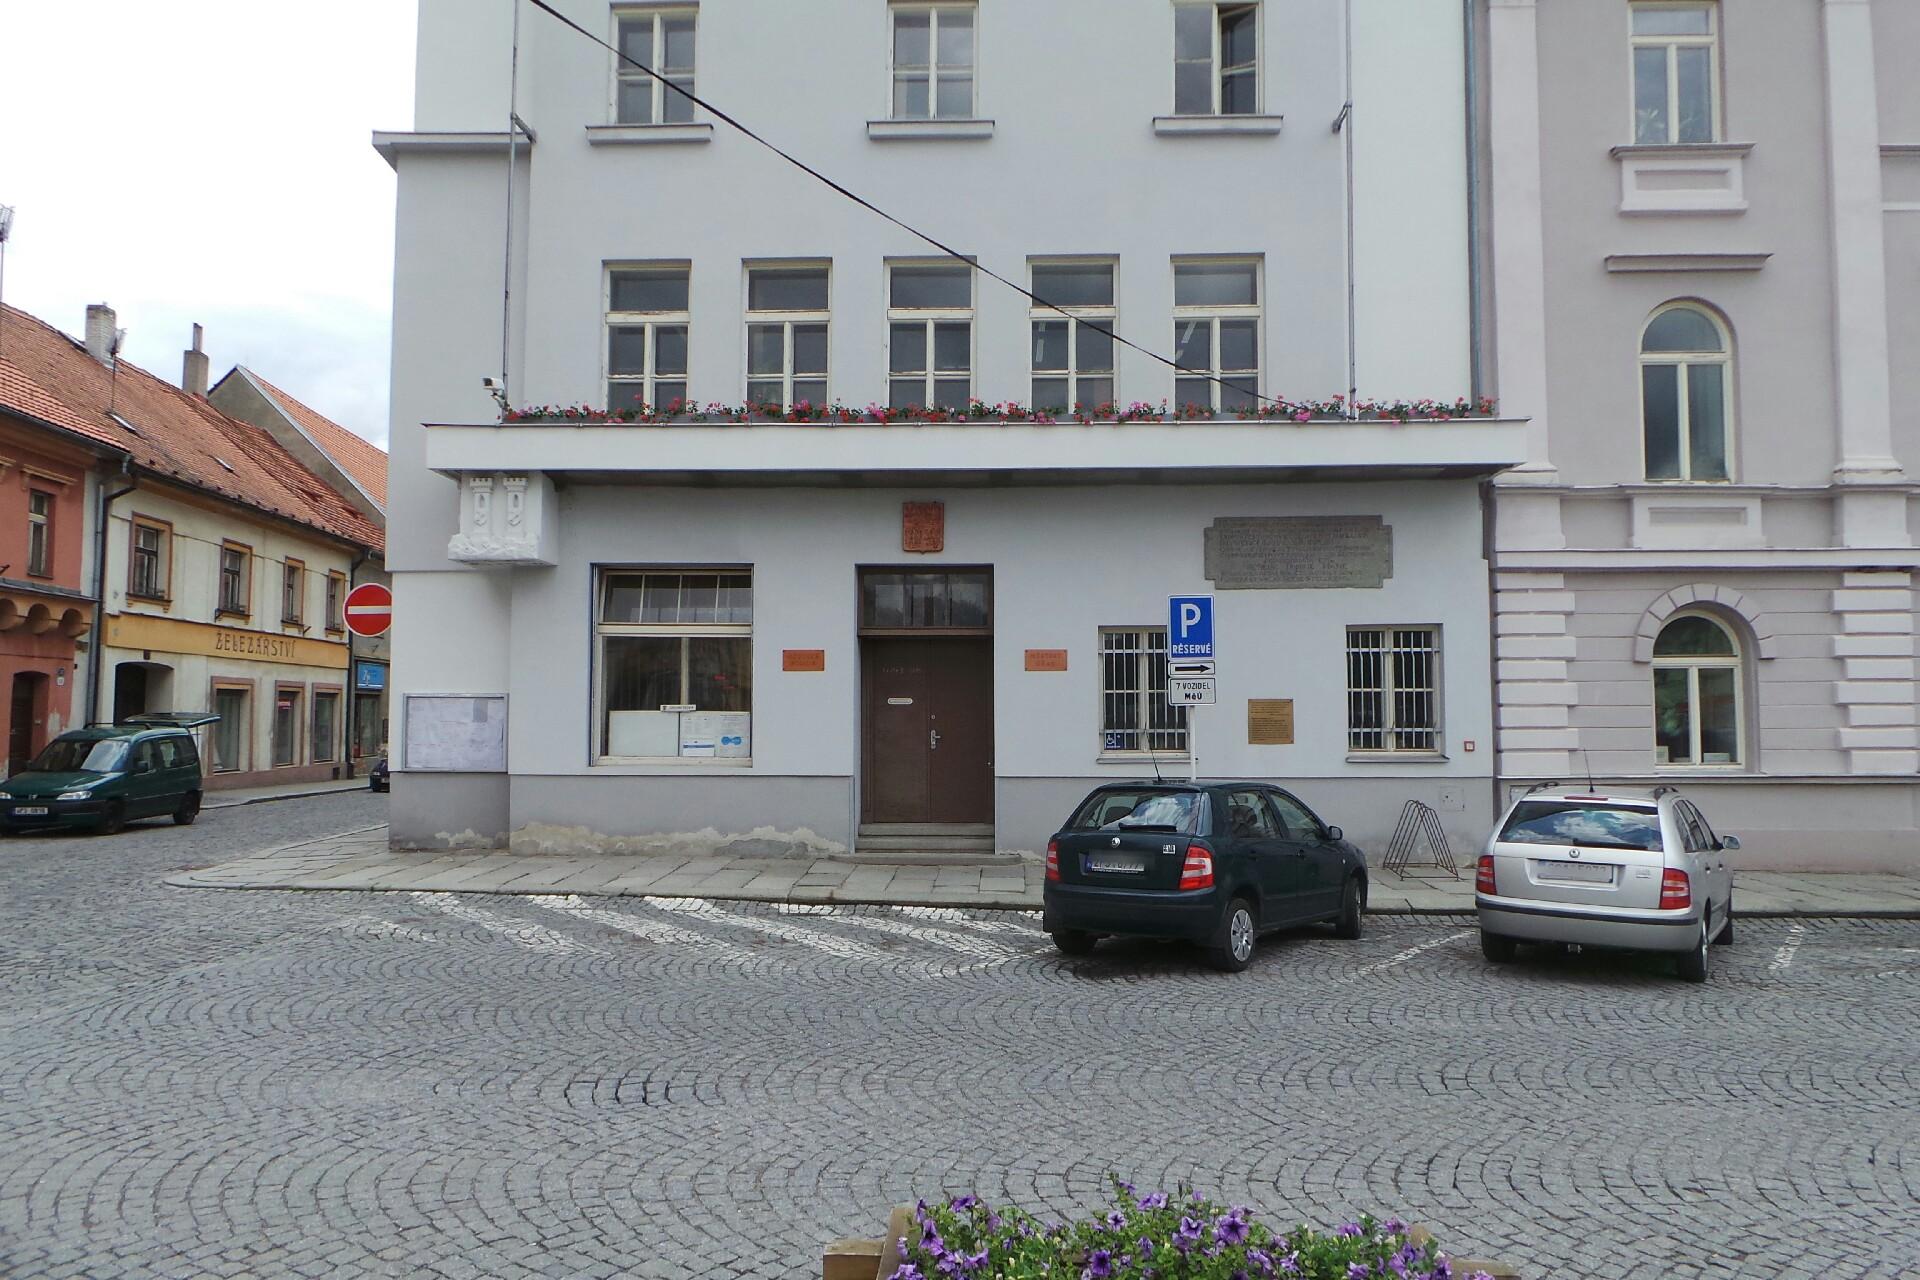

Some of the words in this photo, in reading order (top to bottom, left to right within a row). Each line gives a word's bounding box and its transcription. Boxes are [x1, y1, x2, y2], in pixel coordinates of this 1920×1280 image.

[1180, 603, 1201, 638] P
[1176, 682, 1181, 690] 7
[1182, 682, 1211, 690] VOZIDEL
